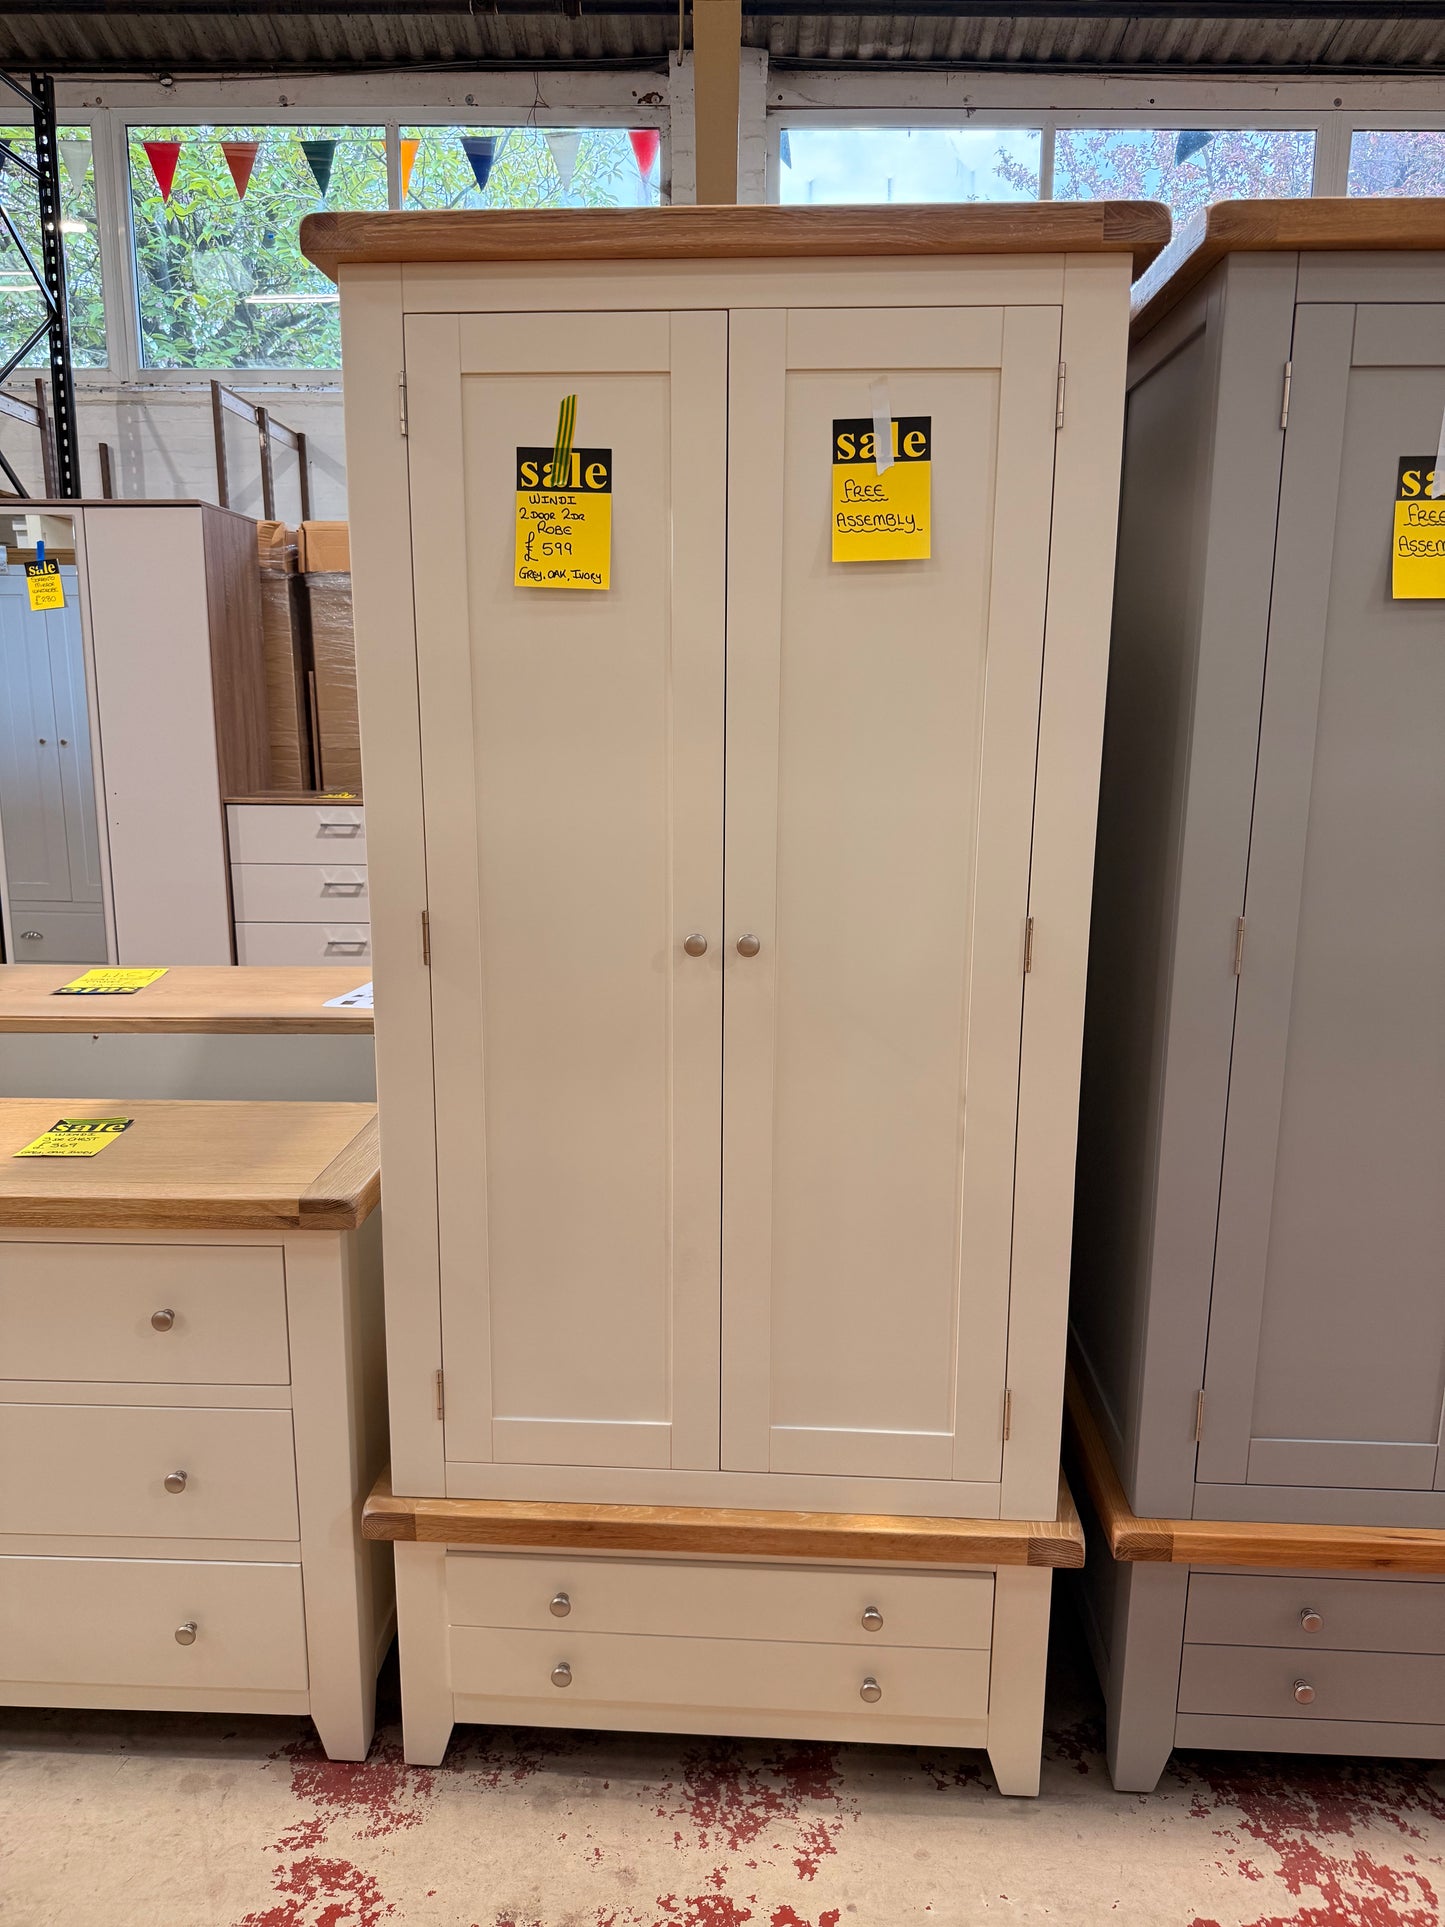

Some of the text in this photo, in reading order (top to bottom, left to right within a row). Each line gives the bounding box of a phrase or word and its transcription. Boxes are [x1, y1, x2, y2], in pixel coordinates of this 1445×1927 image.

[837, 421, 927, 460] sale
[520, 452, 608, 489] sale
[844, 479, 885, 499] FREE
[529, 493, 577, 506] WINDI
[1407, 503, 1445, 523] FREE
[537, 520, 573, 536] ROBE
[836, 512, 916, 534] ASSEMBLY
[28, 561, 56, 576] sale
[570, 568, 603, 584] IVORY
[52, 1123, 126, 1132] sale
